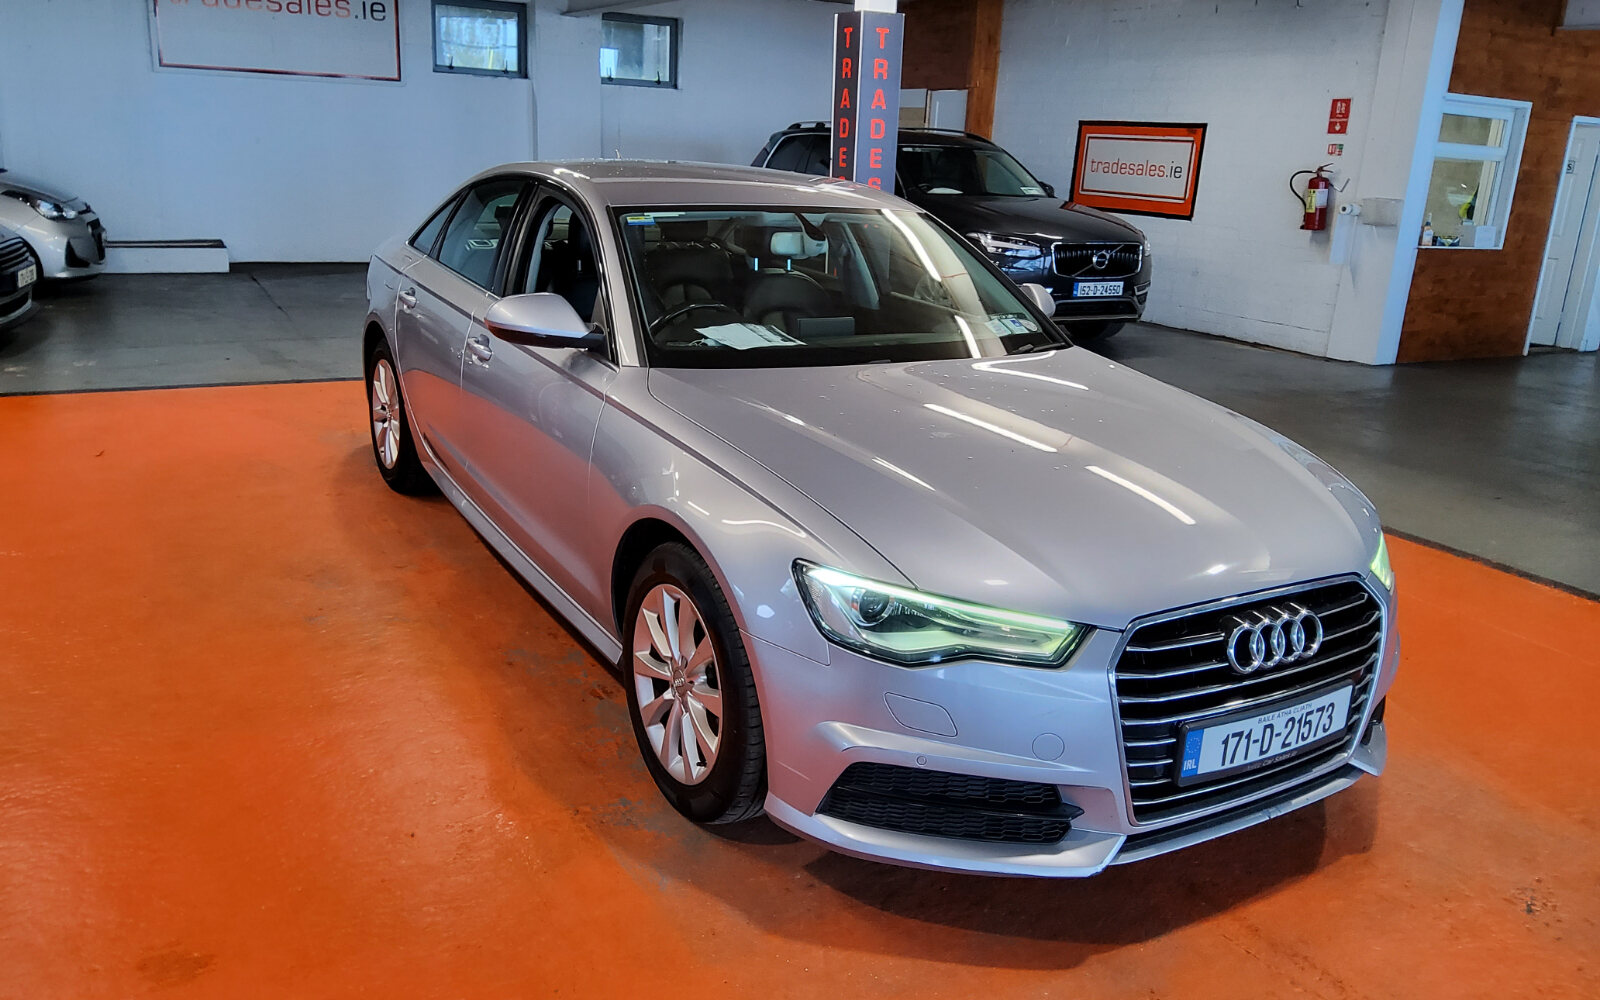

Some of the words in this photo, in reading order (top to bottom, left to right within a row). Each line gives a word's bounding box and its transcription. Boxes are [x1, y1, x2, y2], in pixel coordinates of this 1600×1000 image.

[838, 27, 853, 180] TRADE
[1090, 158, 1183, 179] tradesales.ie
[1221, 702, 1335, 767] 171-D-21573
[1183, 758, 1197, 771] IRL
